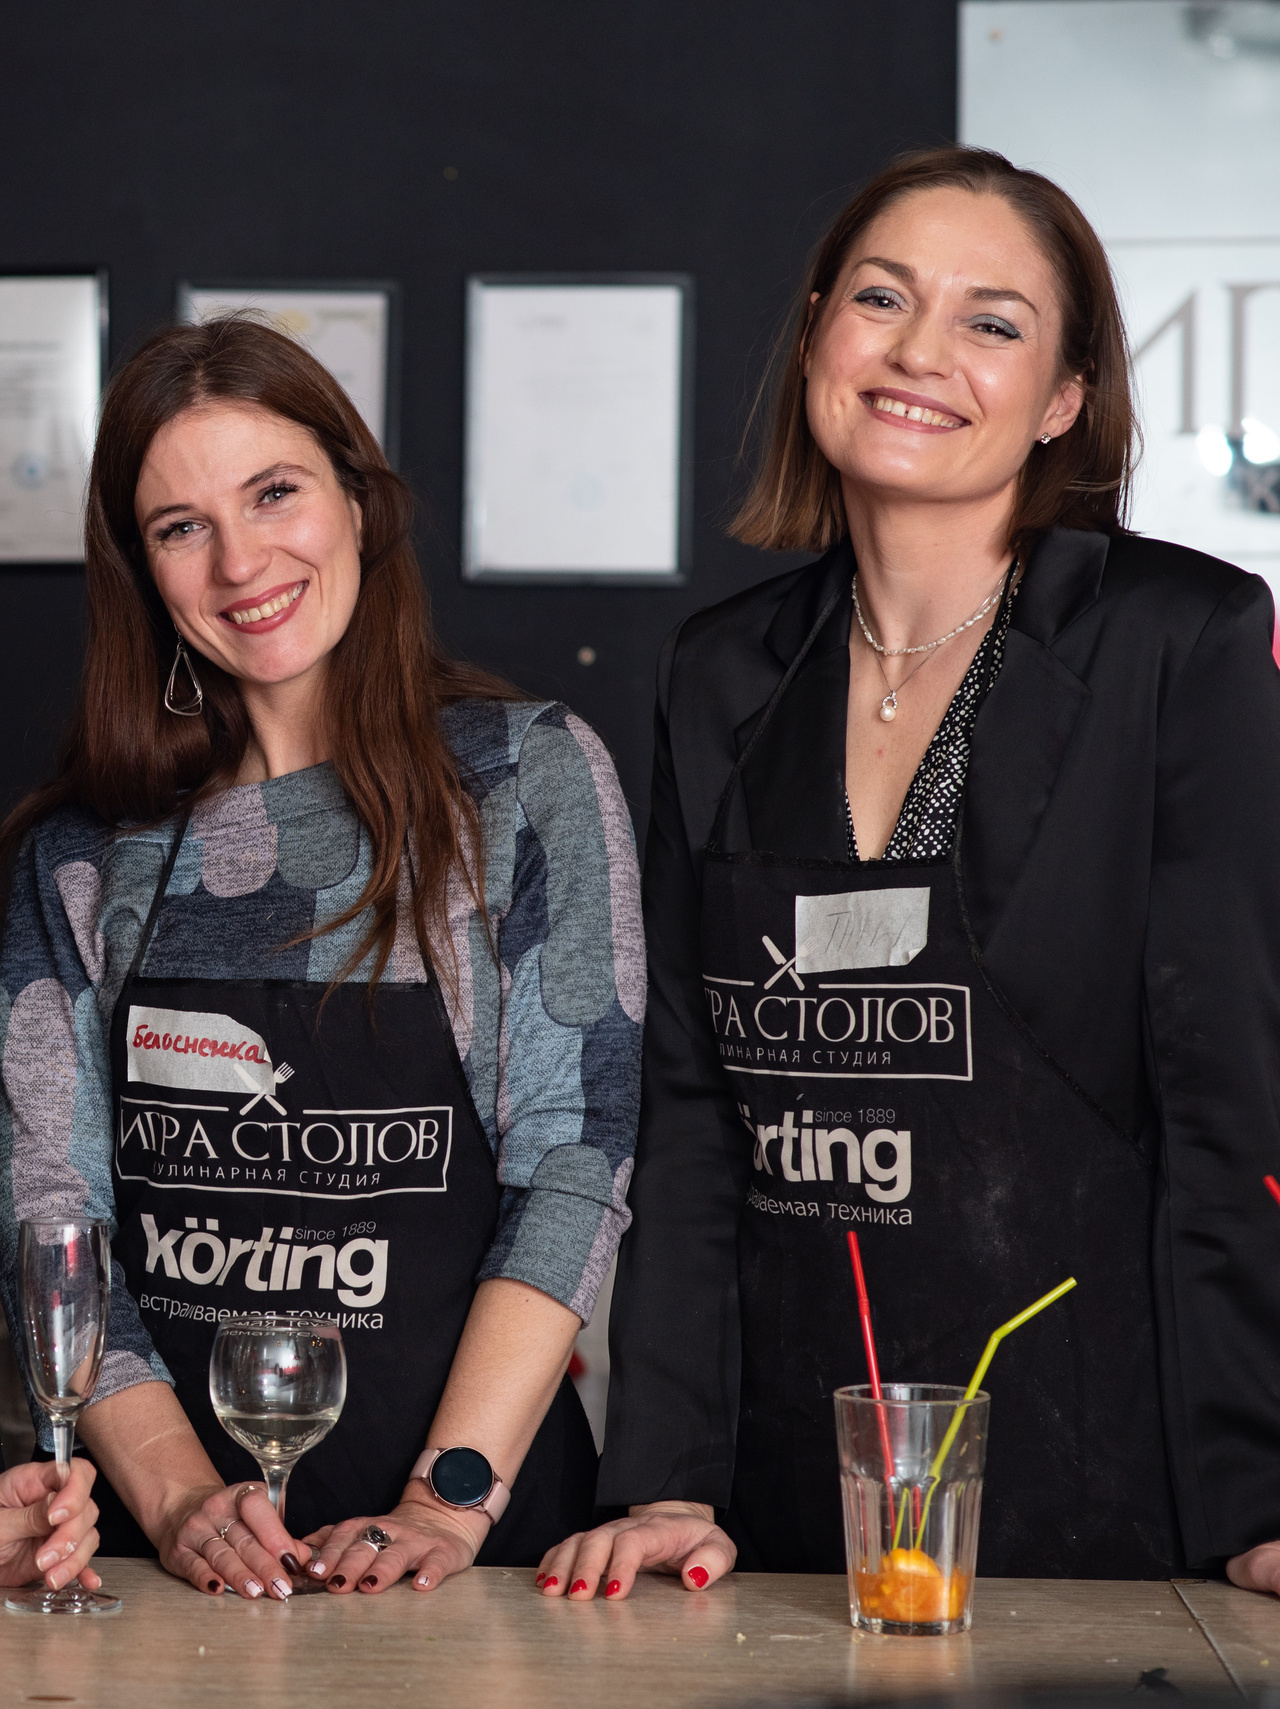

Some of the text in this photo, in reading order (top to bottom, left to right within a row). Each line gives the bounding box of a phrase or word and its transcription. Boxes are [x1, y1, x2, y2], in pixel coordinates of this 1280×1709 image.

[754, 995, 955, 1044] СТОЛОВ
[720, 1043, 892, 1067] ЛИНАРНАЯ СТУДИЯ
[815, 1108, 896, 1124] since 1889
[121, 1109, 440, 1167] ИГРА СТОЛОВ
[738, 1102, 912, 1203] örting
[299, 1170, 381, 1190] СТУДИЯ
[827, 1202, 913, 1226] техника
[294, 1221, 377, 1241] since 1889
[140, 1213, 389, 1308] körting
